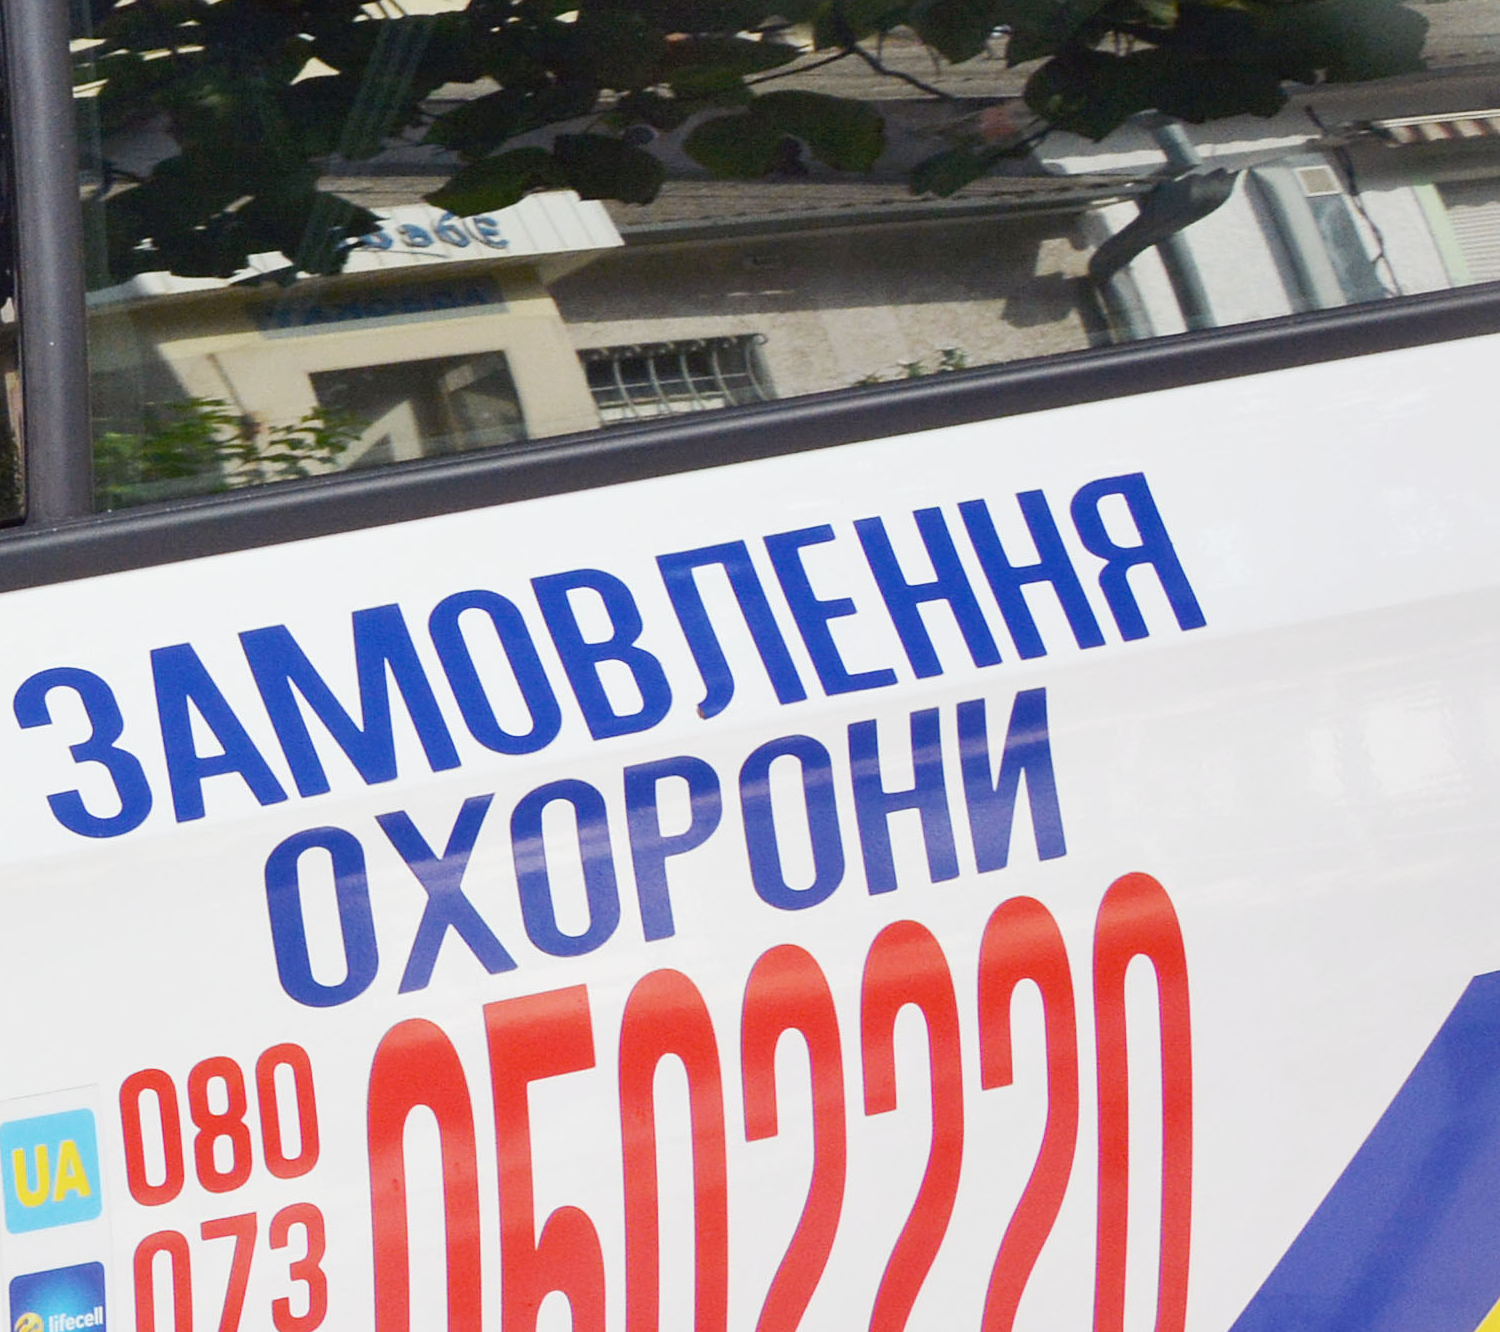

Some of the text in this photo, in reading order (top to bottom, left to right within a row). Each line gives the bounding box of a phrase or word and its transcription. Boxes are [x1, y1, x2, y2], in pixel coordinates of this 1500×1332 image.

[12, 470, 1208, 839] ЗАМОВЛЕННЯ
[263, 686, 1068, 1008] ОХОРОНИ
[12, 1139, 92, 1208] UA
[119, 1042, 321, 1207] 080
